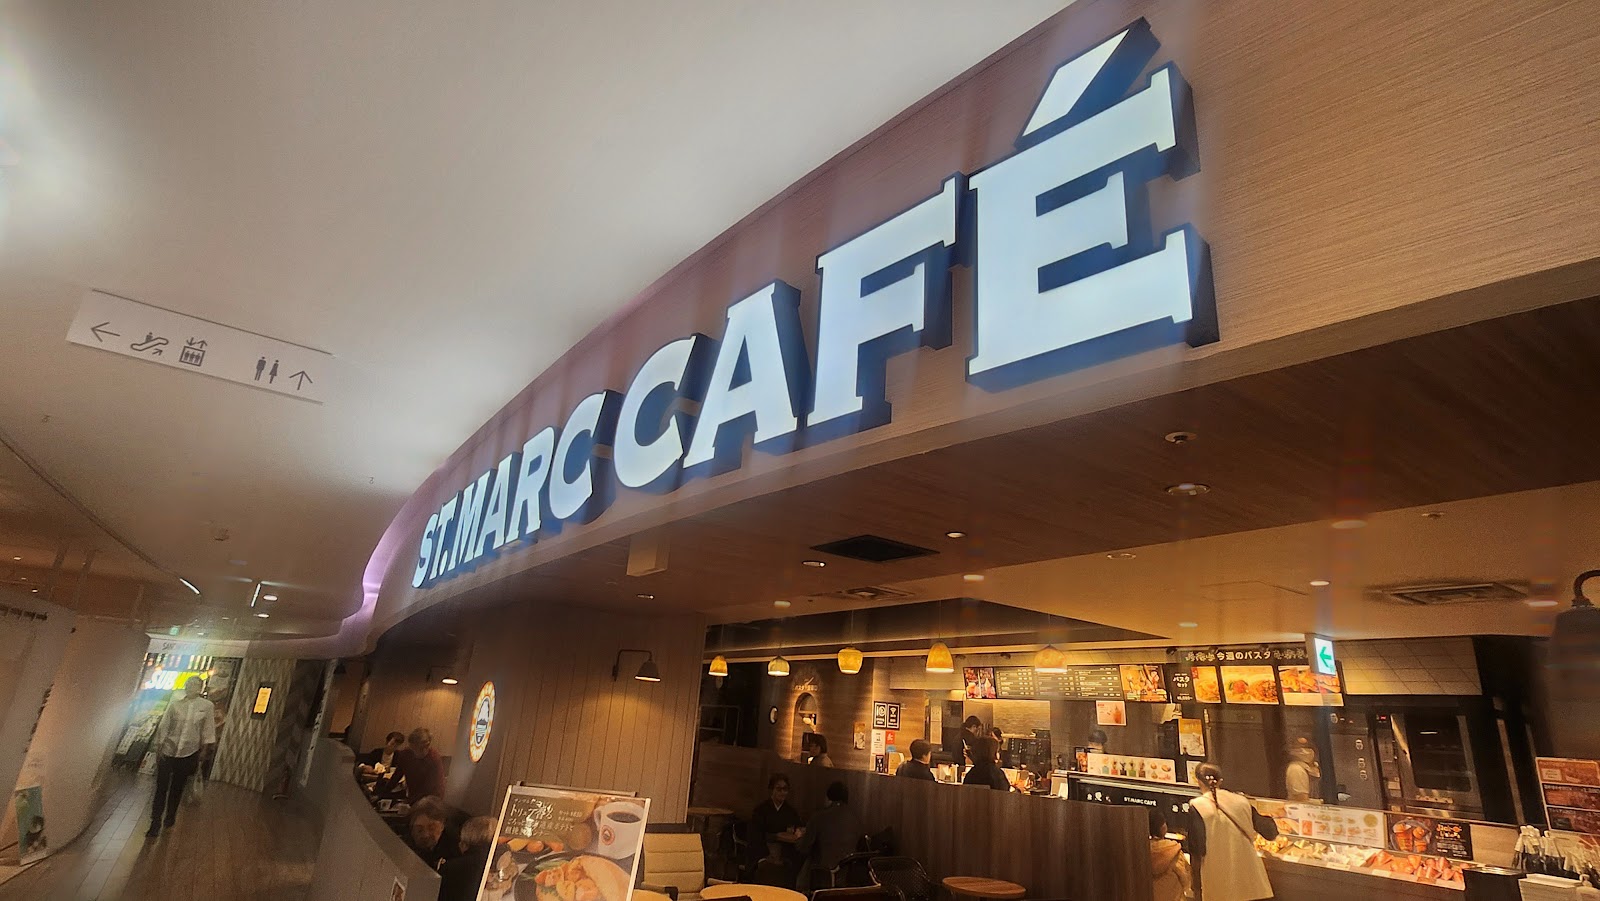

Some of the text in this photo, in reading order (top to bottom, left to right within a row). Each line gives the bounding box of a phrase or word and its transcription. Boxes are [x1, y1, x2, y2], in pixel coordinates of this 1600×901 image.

[412, 28, 1196, 588] ST.MARC CAFÉ
[1216, 651, 1271, 661] 今週のパスタ
